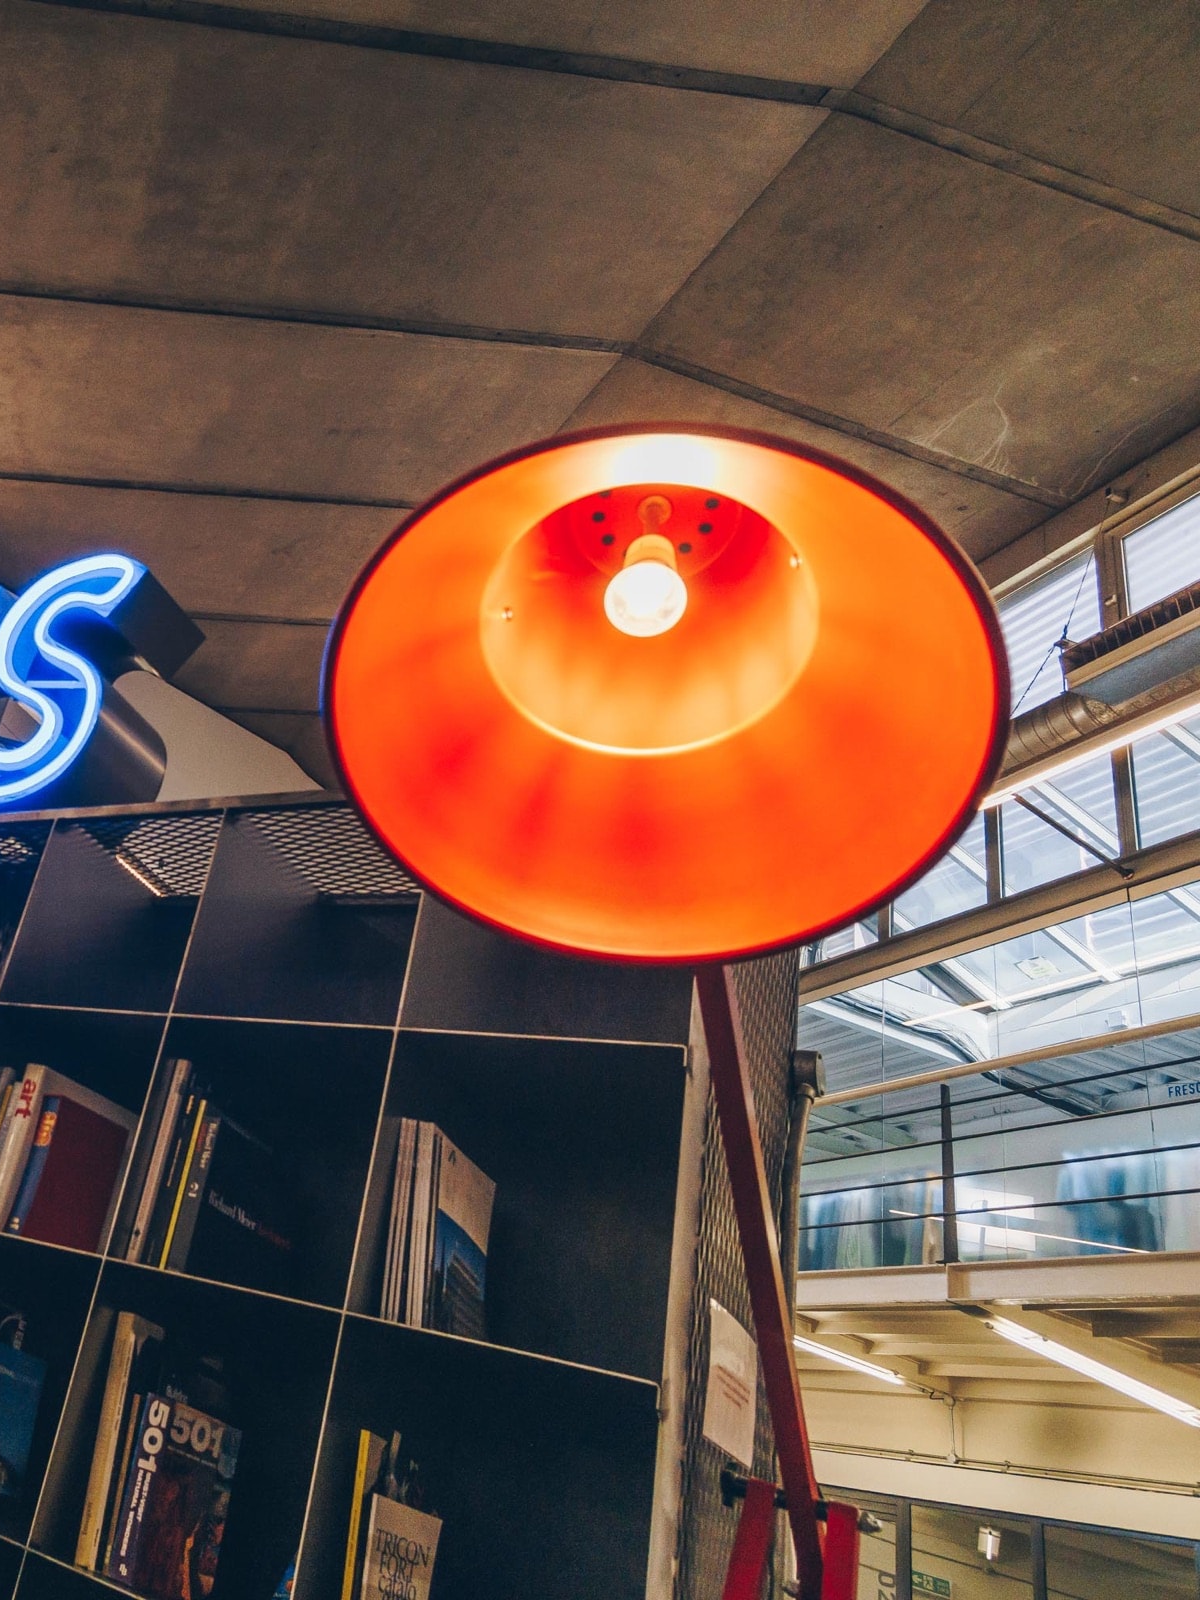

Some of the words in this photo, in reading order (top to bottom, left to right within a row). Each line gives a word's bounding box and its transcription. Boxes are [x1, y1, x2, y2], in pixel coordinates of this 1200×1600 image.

[14, 1078, 37, 1119] art
[138, 1399, 170, 1473] 501
[170, 1408, 225, 1459] 501
[130, 1469, 144, 1509] NATURAL
[136, 1472, 151, 1523] MUST-VISIT
[120, 1510, 135, 1557] WONDERS
[376, 1528, 431, 1568] TRICON
[379, 1551, 415, 1584] FORT
